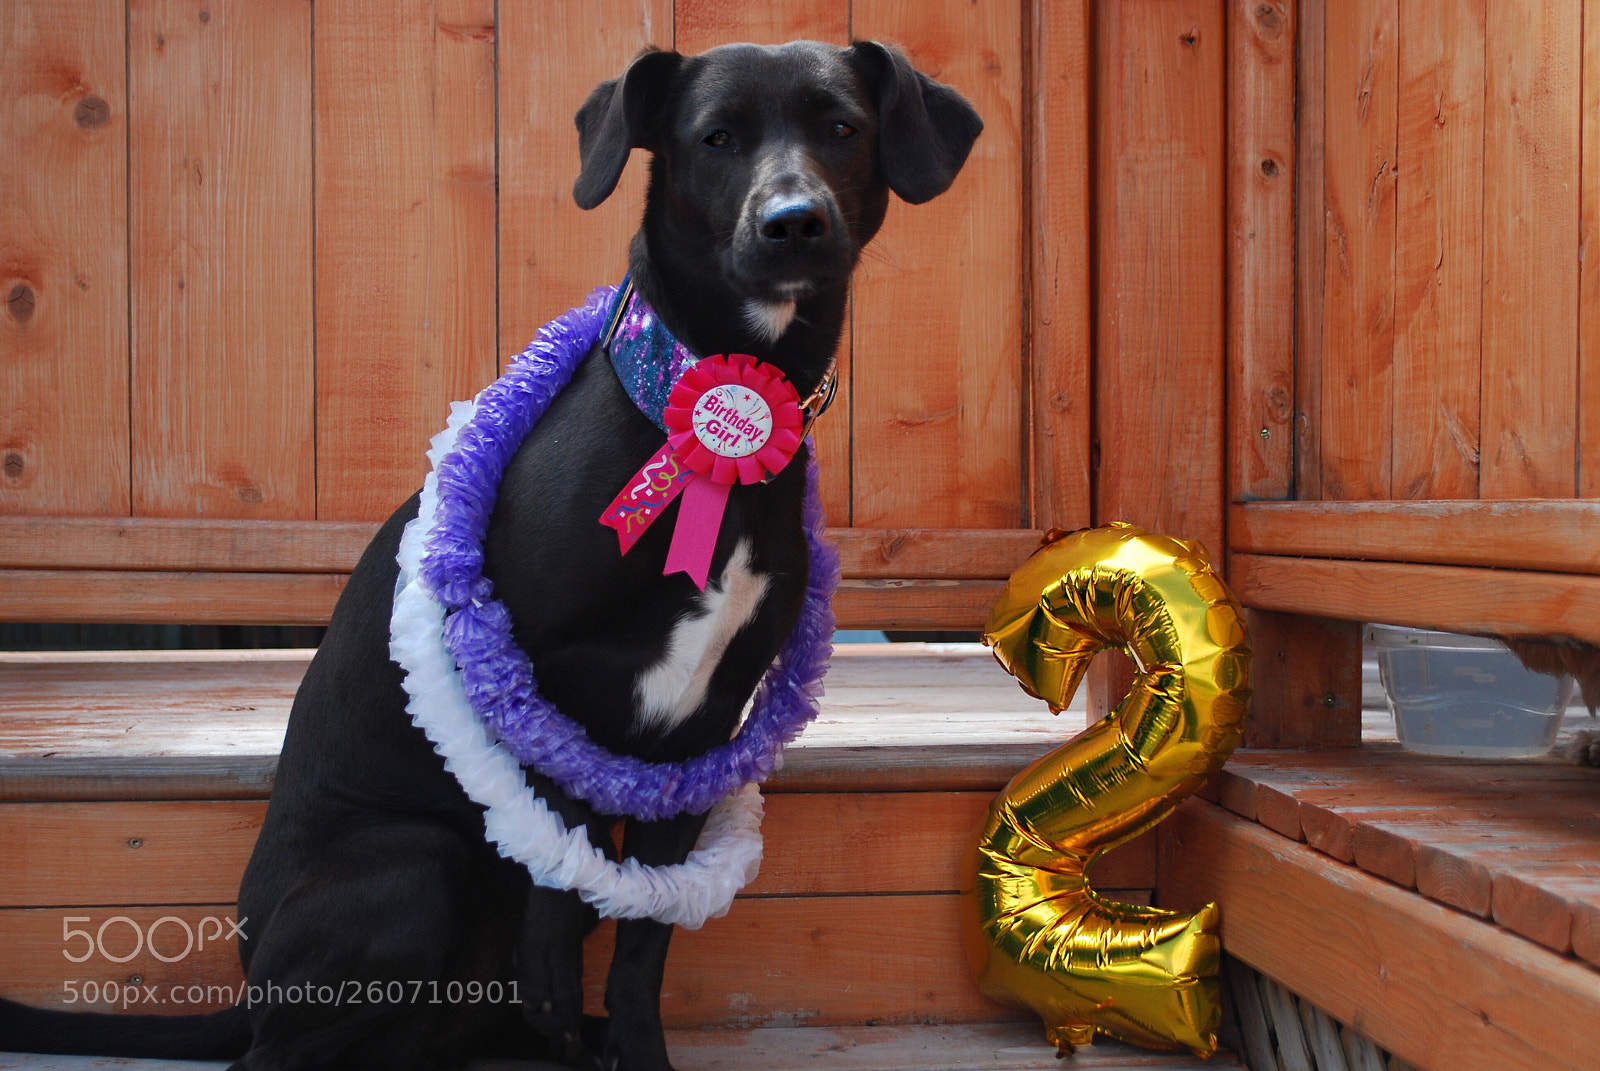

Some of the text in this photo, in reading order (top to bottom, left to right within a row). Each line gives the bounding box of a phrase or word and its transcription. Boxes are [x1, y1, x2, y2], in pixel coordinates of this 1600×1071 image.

[703, 394, 764, 442] Birthday
[705, 419, 742, 448] Girl
[980, 521, 1254, 1059] 2
